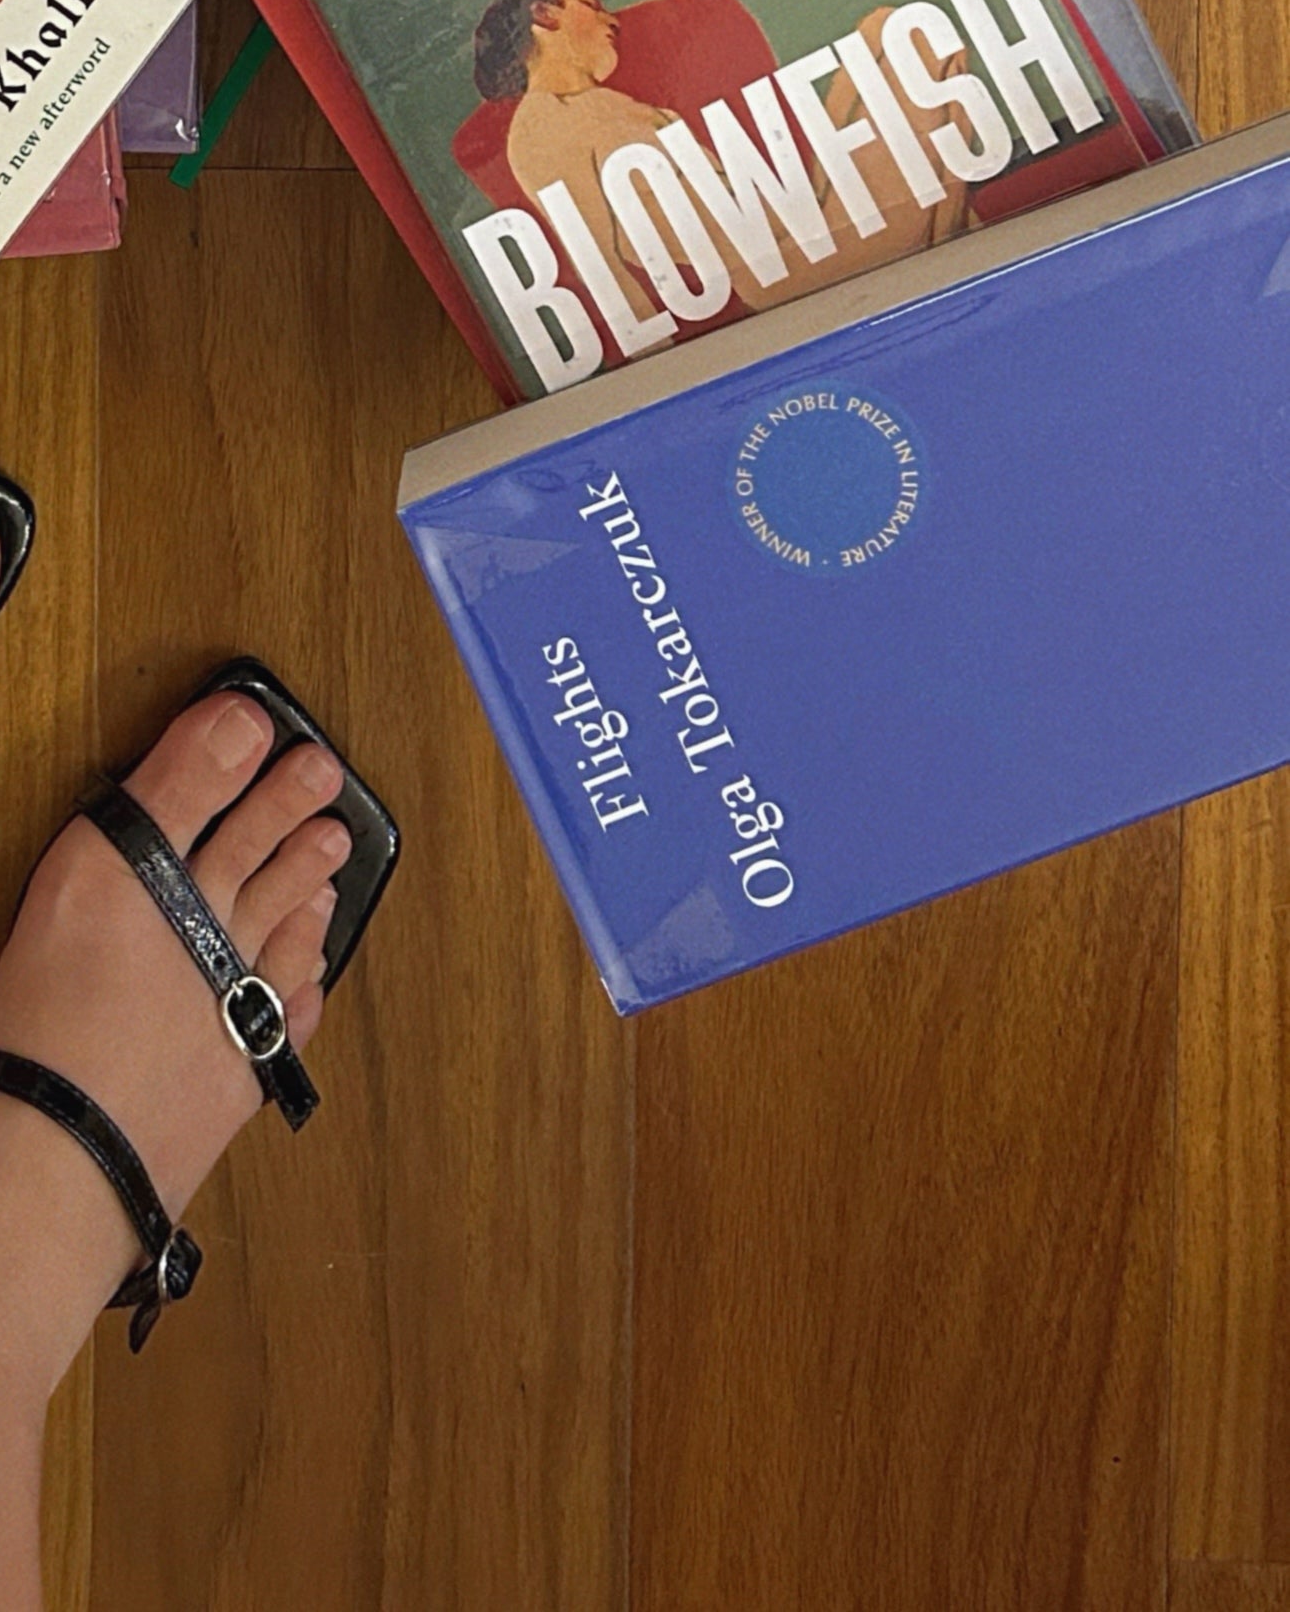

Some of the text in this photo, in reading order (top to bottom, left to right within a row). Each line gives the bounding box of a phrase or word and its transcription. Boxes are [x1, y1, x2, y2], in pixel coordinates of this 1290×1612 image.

[9, 131, 41, 170] new
[39, 37, 112, 130] afterword
[736, 393, 919, 567] WINNER OF THE NOBEL PRIZE IN LITERATURE
[542, 636, 649, 832] Flights
[578, 470, 795, 908] Olga Tokarczuk
